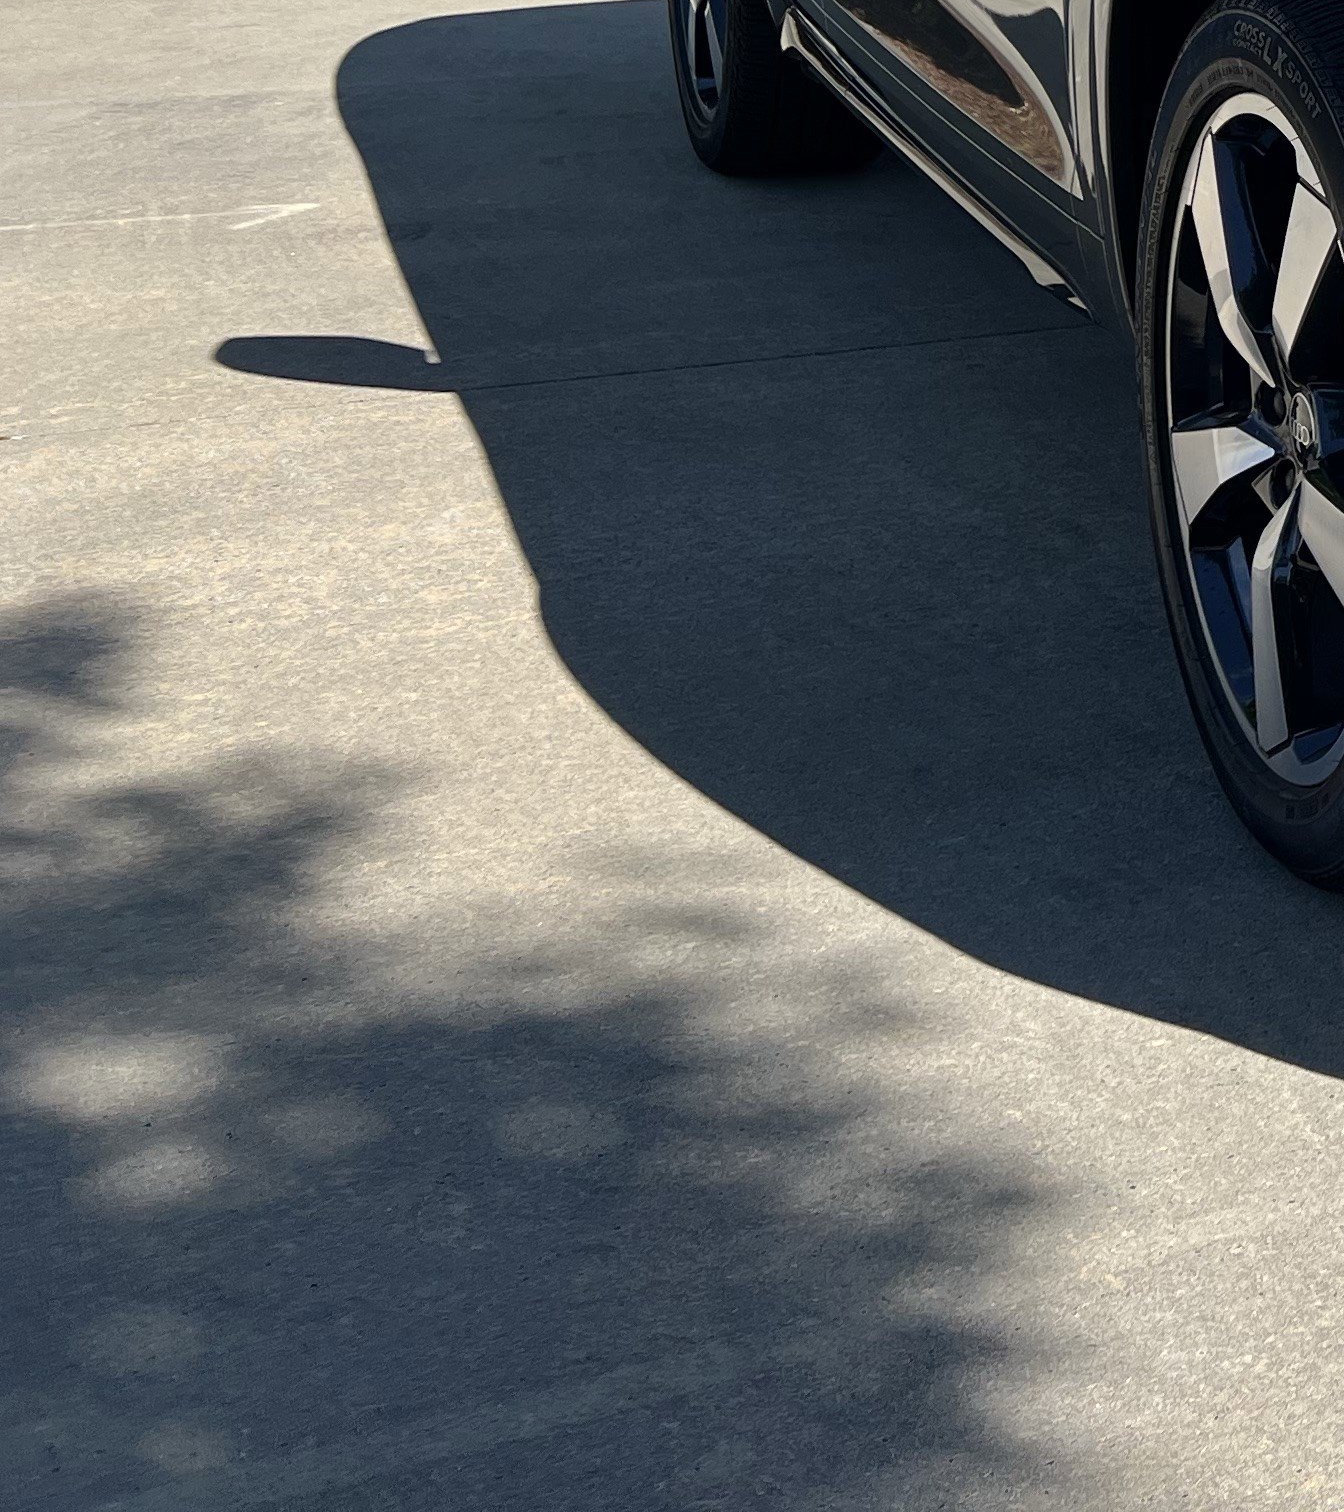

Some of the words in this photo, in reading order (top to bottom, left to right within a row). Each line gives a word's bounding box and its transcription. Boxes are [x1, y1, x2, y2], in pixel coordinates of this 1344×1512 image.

[1233, 19, 1266, 48] CROSS
[1262, 37, 1288, 78] LX
[1285, 61, 1322, 118] SPORT
